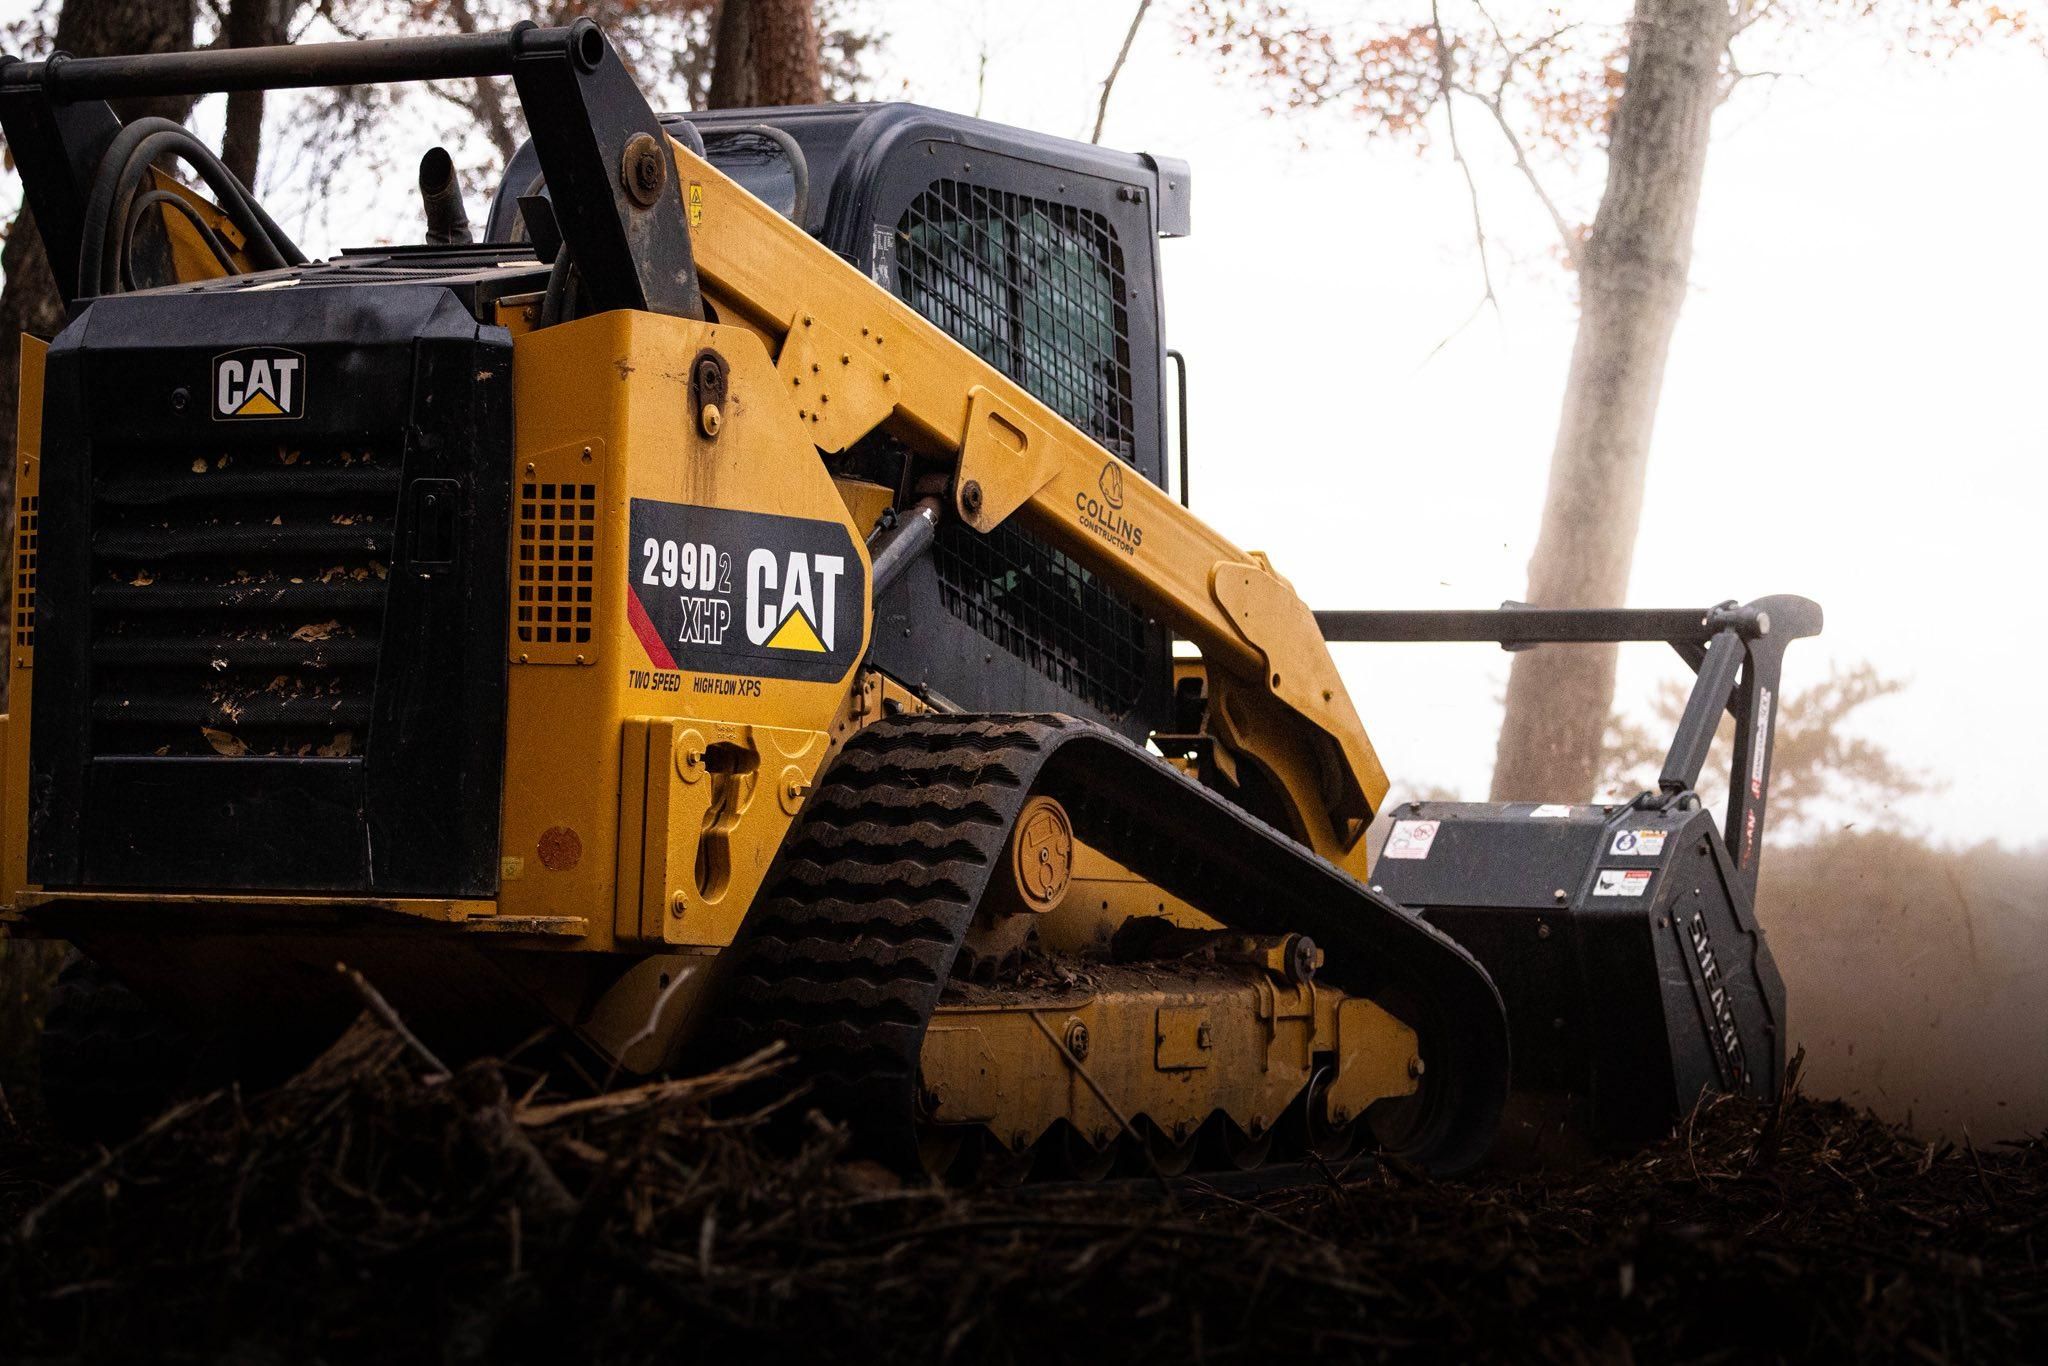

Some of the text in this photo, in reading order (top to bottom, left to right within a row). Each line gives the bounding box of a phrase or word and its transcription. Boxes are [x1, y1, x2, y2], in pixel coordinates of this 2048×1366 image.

[218, 358, 299, 415] CAT
[1076, 492, 1143, 547] COLLINS
[1079, 515, 1135, 556] CONSTRUCTORS
[642, 537, 732, 594] 299D2
[678, 595, 731, 645] XHP
[745, 547, 845, 653] CAT
[629, 669, 681, 693] TWO SPEED
[693, 676, 762, 698] HIGH FLOW XPS
